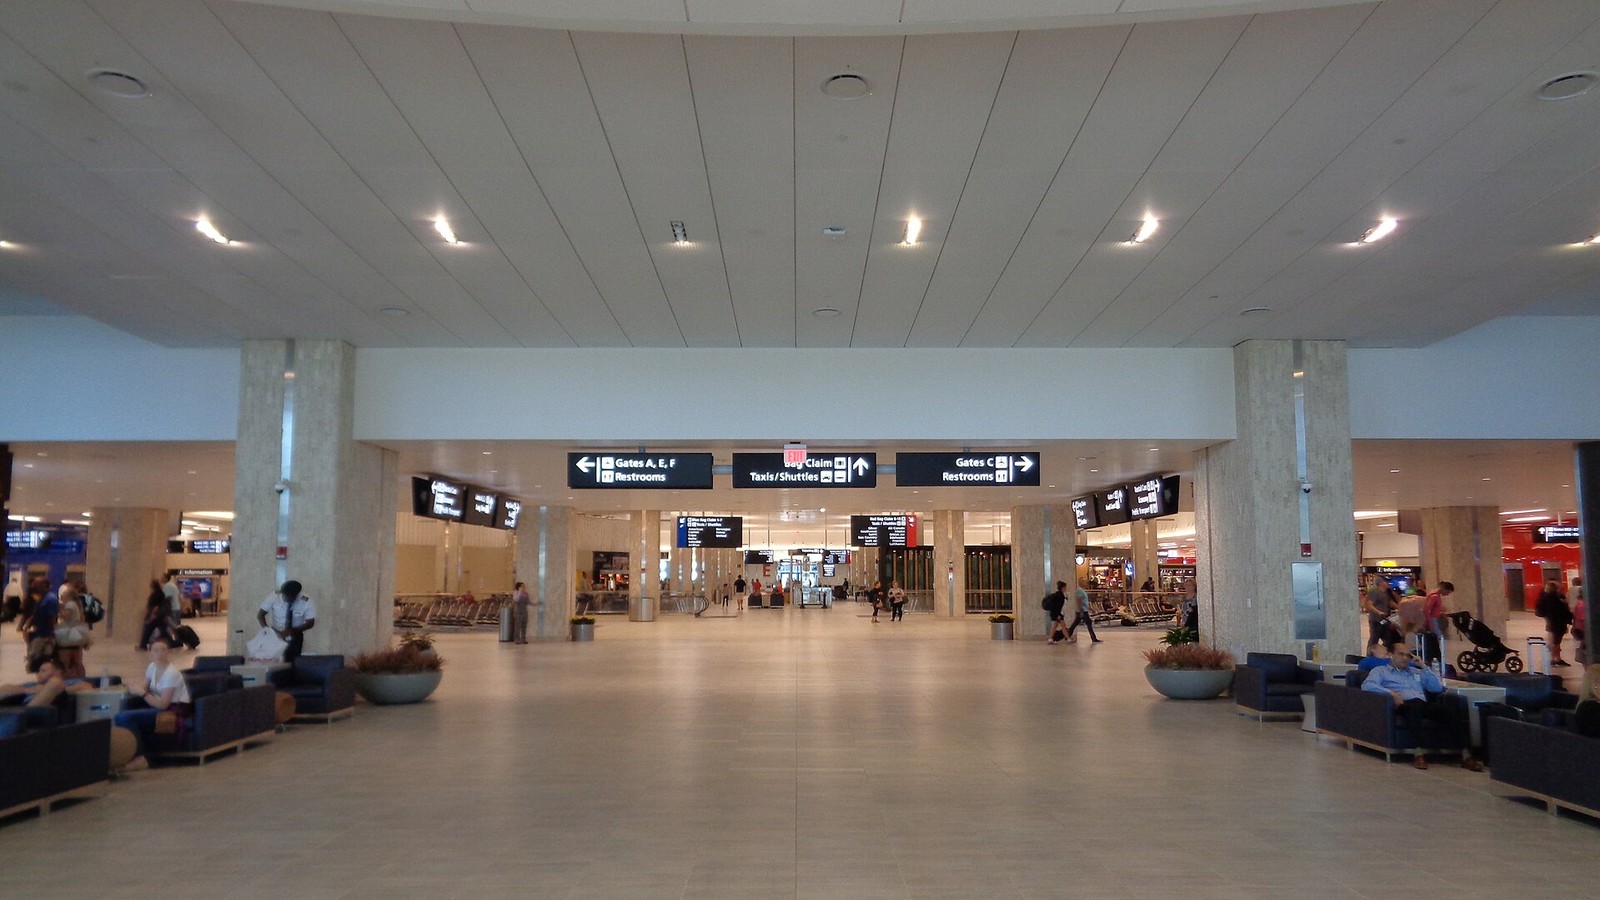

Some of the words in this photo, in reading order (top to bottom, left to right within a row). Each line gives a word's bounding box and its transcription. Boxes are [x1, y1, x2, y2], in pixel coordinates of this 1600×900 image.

[615, 459, 644, 468] Gates
[645, 459, 656, 469] A,
[658, 459, 668, 469] E,
[669, 459, 676, 468] F
[805, 459, 833, 468] Claim
[956, 458, 985, 467] Gates
[986, 458, 994, 467] C
[615, 472, 666, 482] Restrooms
[942, 472, 994, 481] Restrooms
